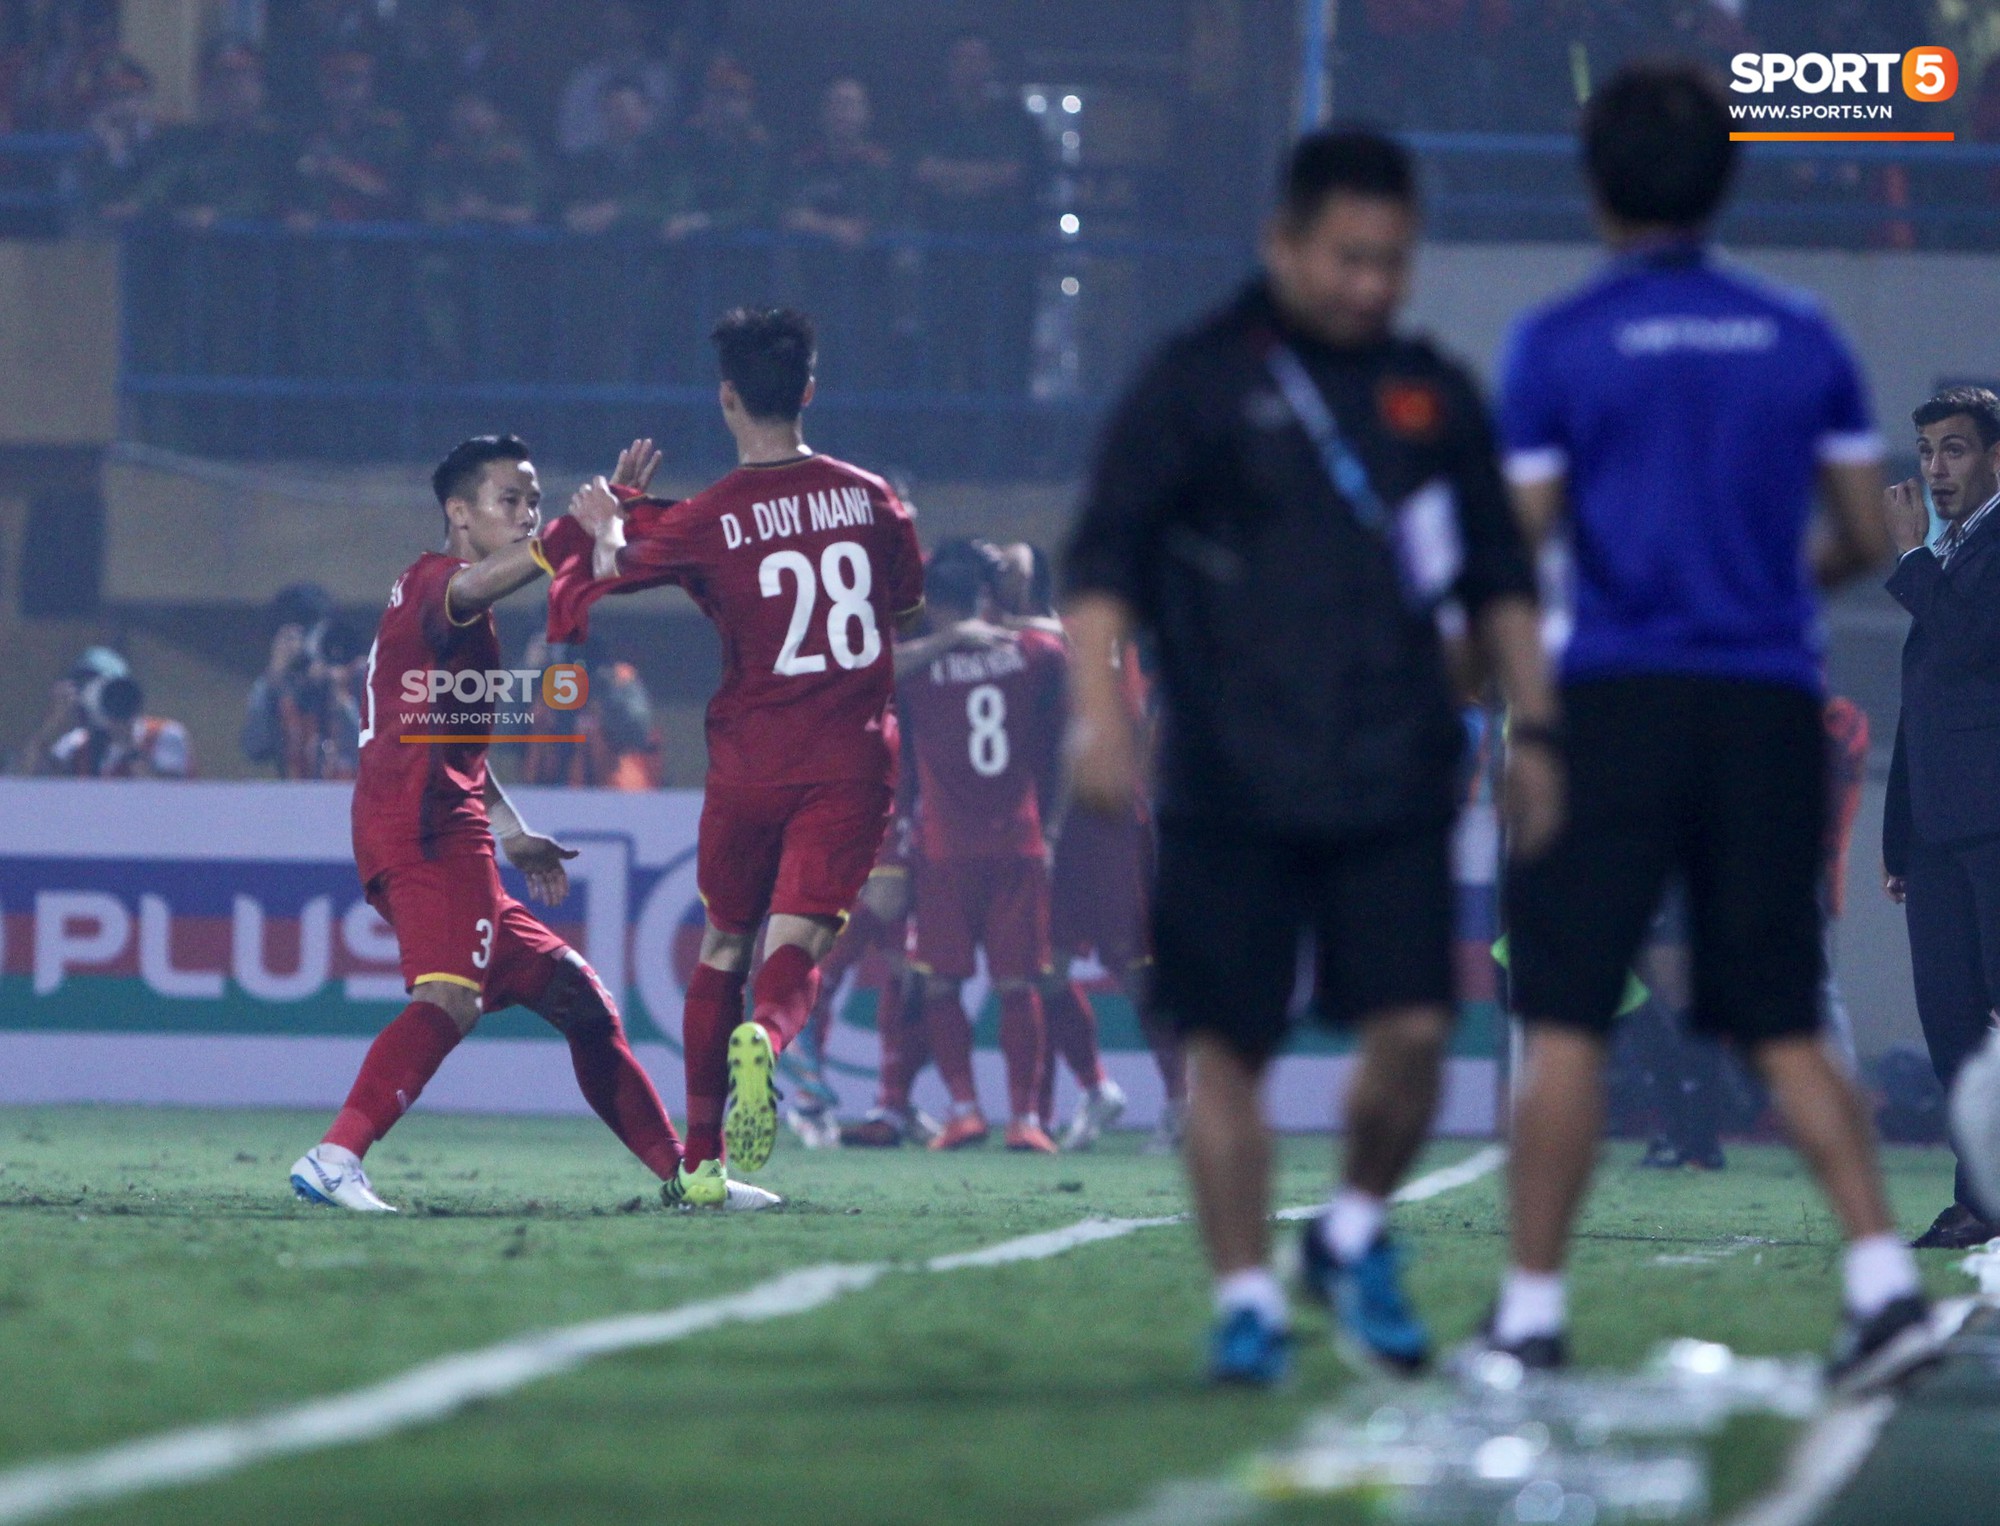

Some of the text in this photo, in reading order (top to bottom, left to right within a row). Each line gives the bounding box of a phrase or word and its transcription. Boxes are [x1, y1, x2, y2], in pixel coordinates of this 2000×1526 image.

[720, 487, 874, 550] D. DUY MANH
[758, 541, 881, 676] 28
[966, 683, 1010, 777] 8
[472, 918, 493, 969] 3
